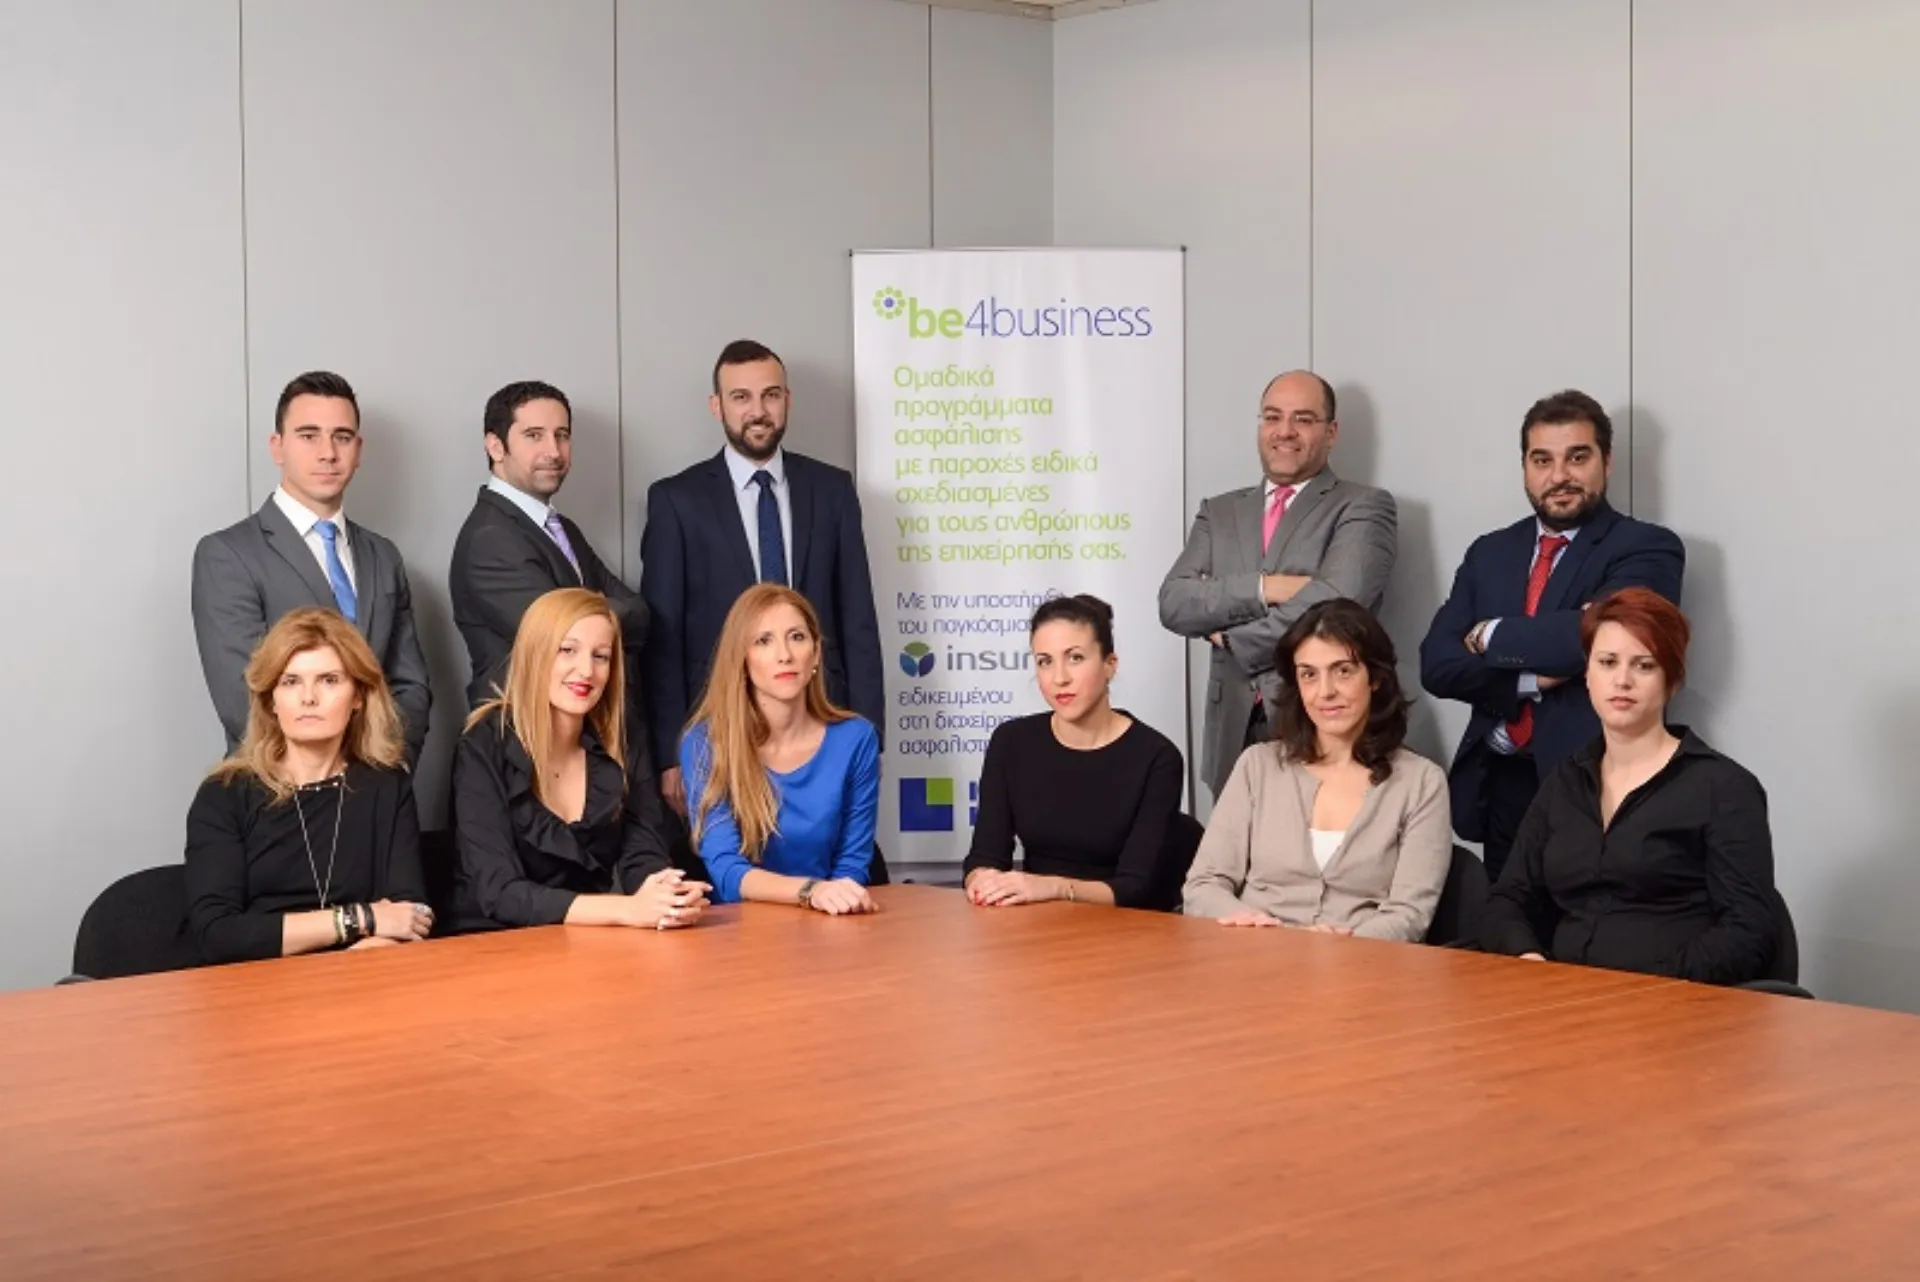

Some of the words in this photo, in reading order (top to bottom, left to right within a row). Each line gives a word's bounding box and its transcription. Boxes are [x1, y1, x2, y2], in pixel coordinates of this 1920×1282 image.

[908, 297, 1153, 338] be4business
[894, 364, 995, 391] Ομαδικά
[894, 397, 1053, 421] προγράμματα
[895, 423, 1022, 450] ασφάλισης
[896, 457, 922, 479] με
[929, 452, 1025, 478] παροχές
[1032, 449, 1098, 474] ειδικά
[895, 480, 1050, 507] σχεδιασμένες
[896, 515, 930, 537] για
[938, 514, 988, 533] τους
[995, 508, 1131, 536] ανθρώπους
[897, 545, 932, 563] της
[938, 538, 1074, 566] επιχείρησής
[1080, 542, 1127, 561] σας.
[897, 592, 927, 610] Με
[931, 594, 958, 609] την
[898, 618, 927, 634] του
[933, 615, 1032, 637] παγκόσμιο
[947, 645, 1033, 671] insur
[899, 686, 1013, 708] ειδικευμένου
[899, 715, 929, 731] στη
